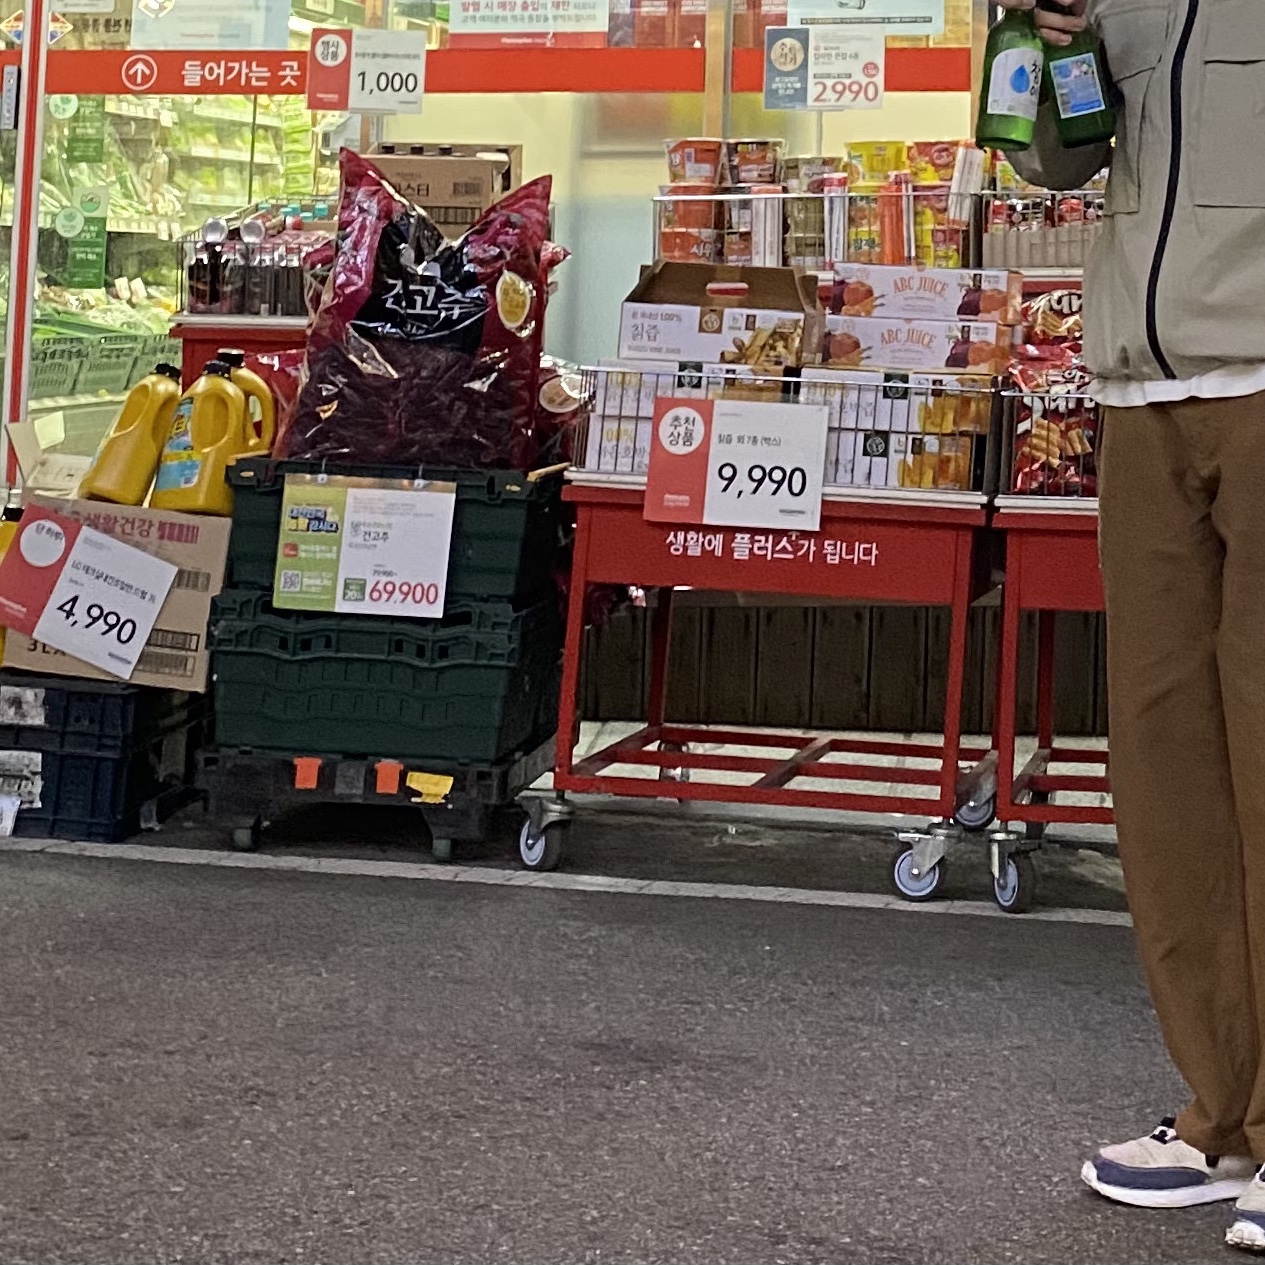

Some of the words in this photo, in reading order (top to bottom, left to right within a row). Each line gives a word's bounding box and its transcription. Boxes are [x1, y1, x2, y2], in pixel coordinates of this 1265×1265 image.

[181, 61, 271, 87] 들어가는
[277, 61, 301, 87] 곳
[357, 70, 418, 96] 1,000
[893, 277, 914, 294] ABC
[918, 276, 949, 298] JUICE
[880, 329, 902, 345] ABC
[905, 328, 937, 349] JUICE
[669, 415, 696, 432] 추천
[668, 432, 694, 447] 상품
[717, 462, 807, 499] 9,990
[362, 531, 390, 543] 건고추
[665, 530, 723, 556] 생활에
[731, 532, 817, 563] 플러스가
[822, 541, 879, 567] 됩니다
[369, 580, 439, 606] 69,900
[57, 594, 137, 644] 4,990
